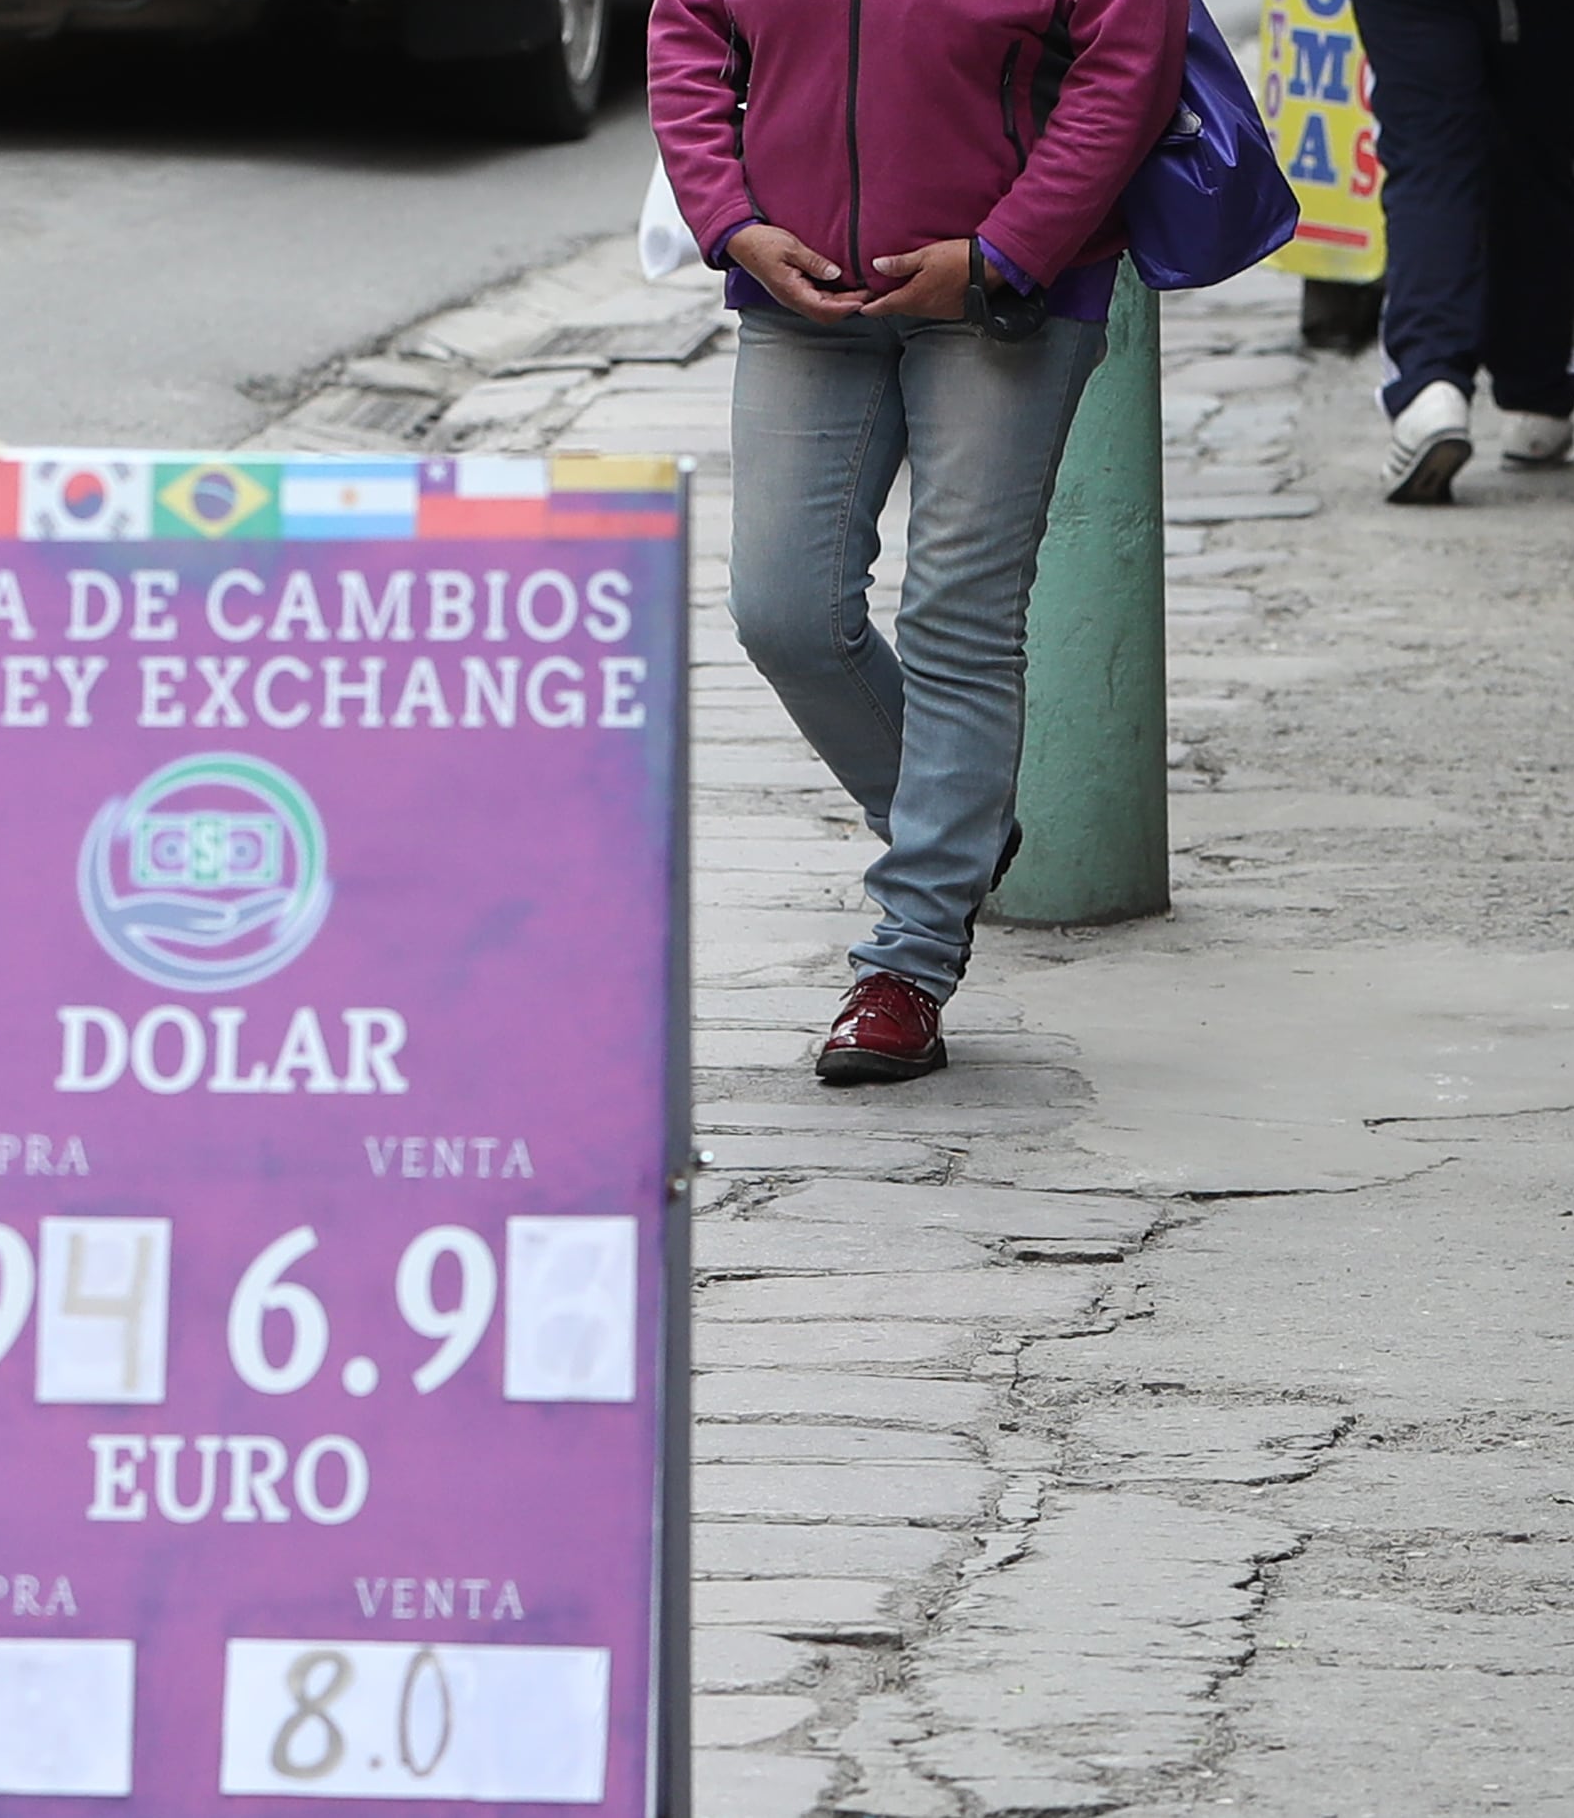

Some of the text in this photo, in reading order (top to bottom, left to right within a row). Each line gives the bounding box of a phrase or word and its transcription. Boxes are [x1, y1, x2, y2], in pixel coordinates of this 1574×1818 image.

[66, 568, 179, 643] DE
[205, 566, 633, 644] CAMBIOS
[136, 656, 648, 731] EXCHANGE
[54, 1005, 409, 1096] DOLAR
[363, 1136, 535, 1180] VENTA
[86, 1433, 370, 1526] EURO
[353, 1577, 525, 1621] VENTA
[269, 1644, 453, 1780] 8.0
